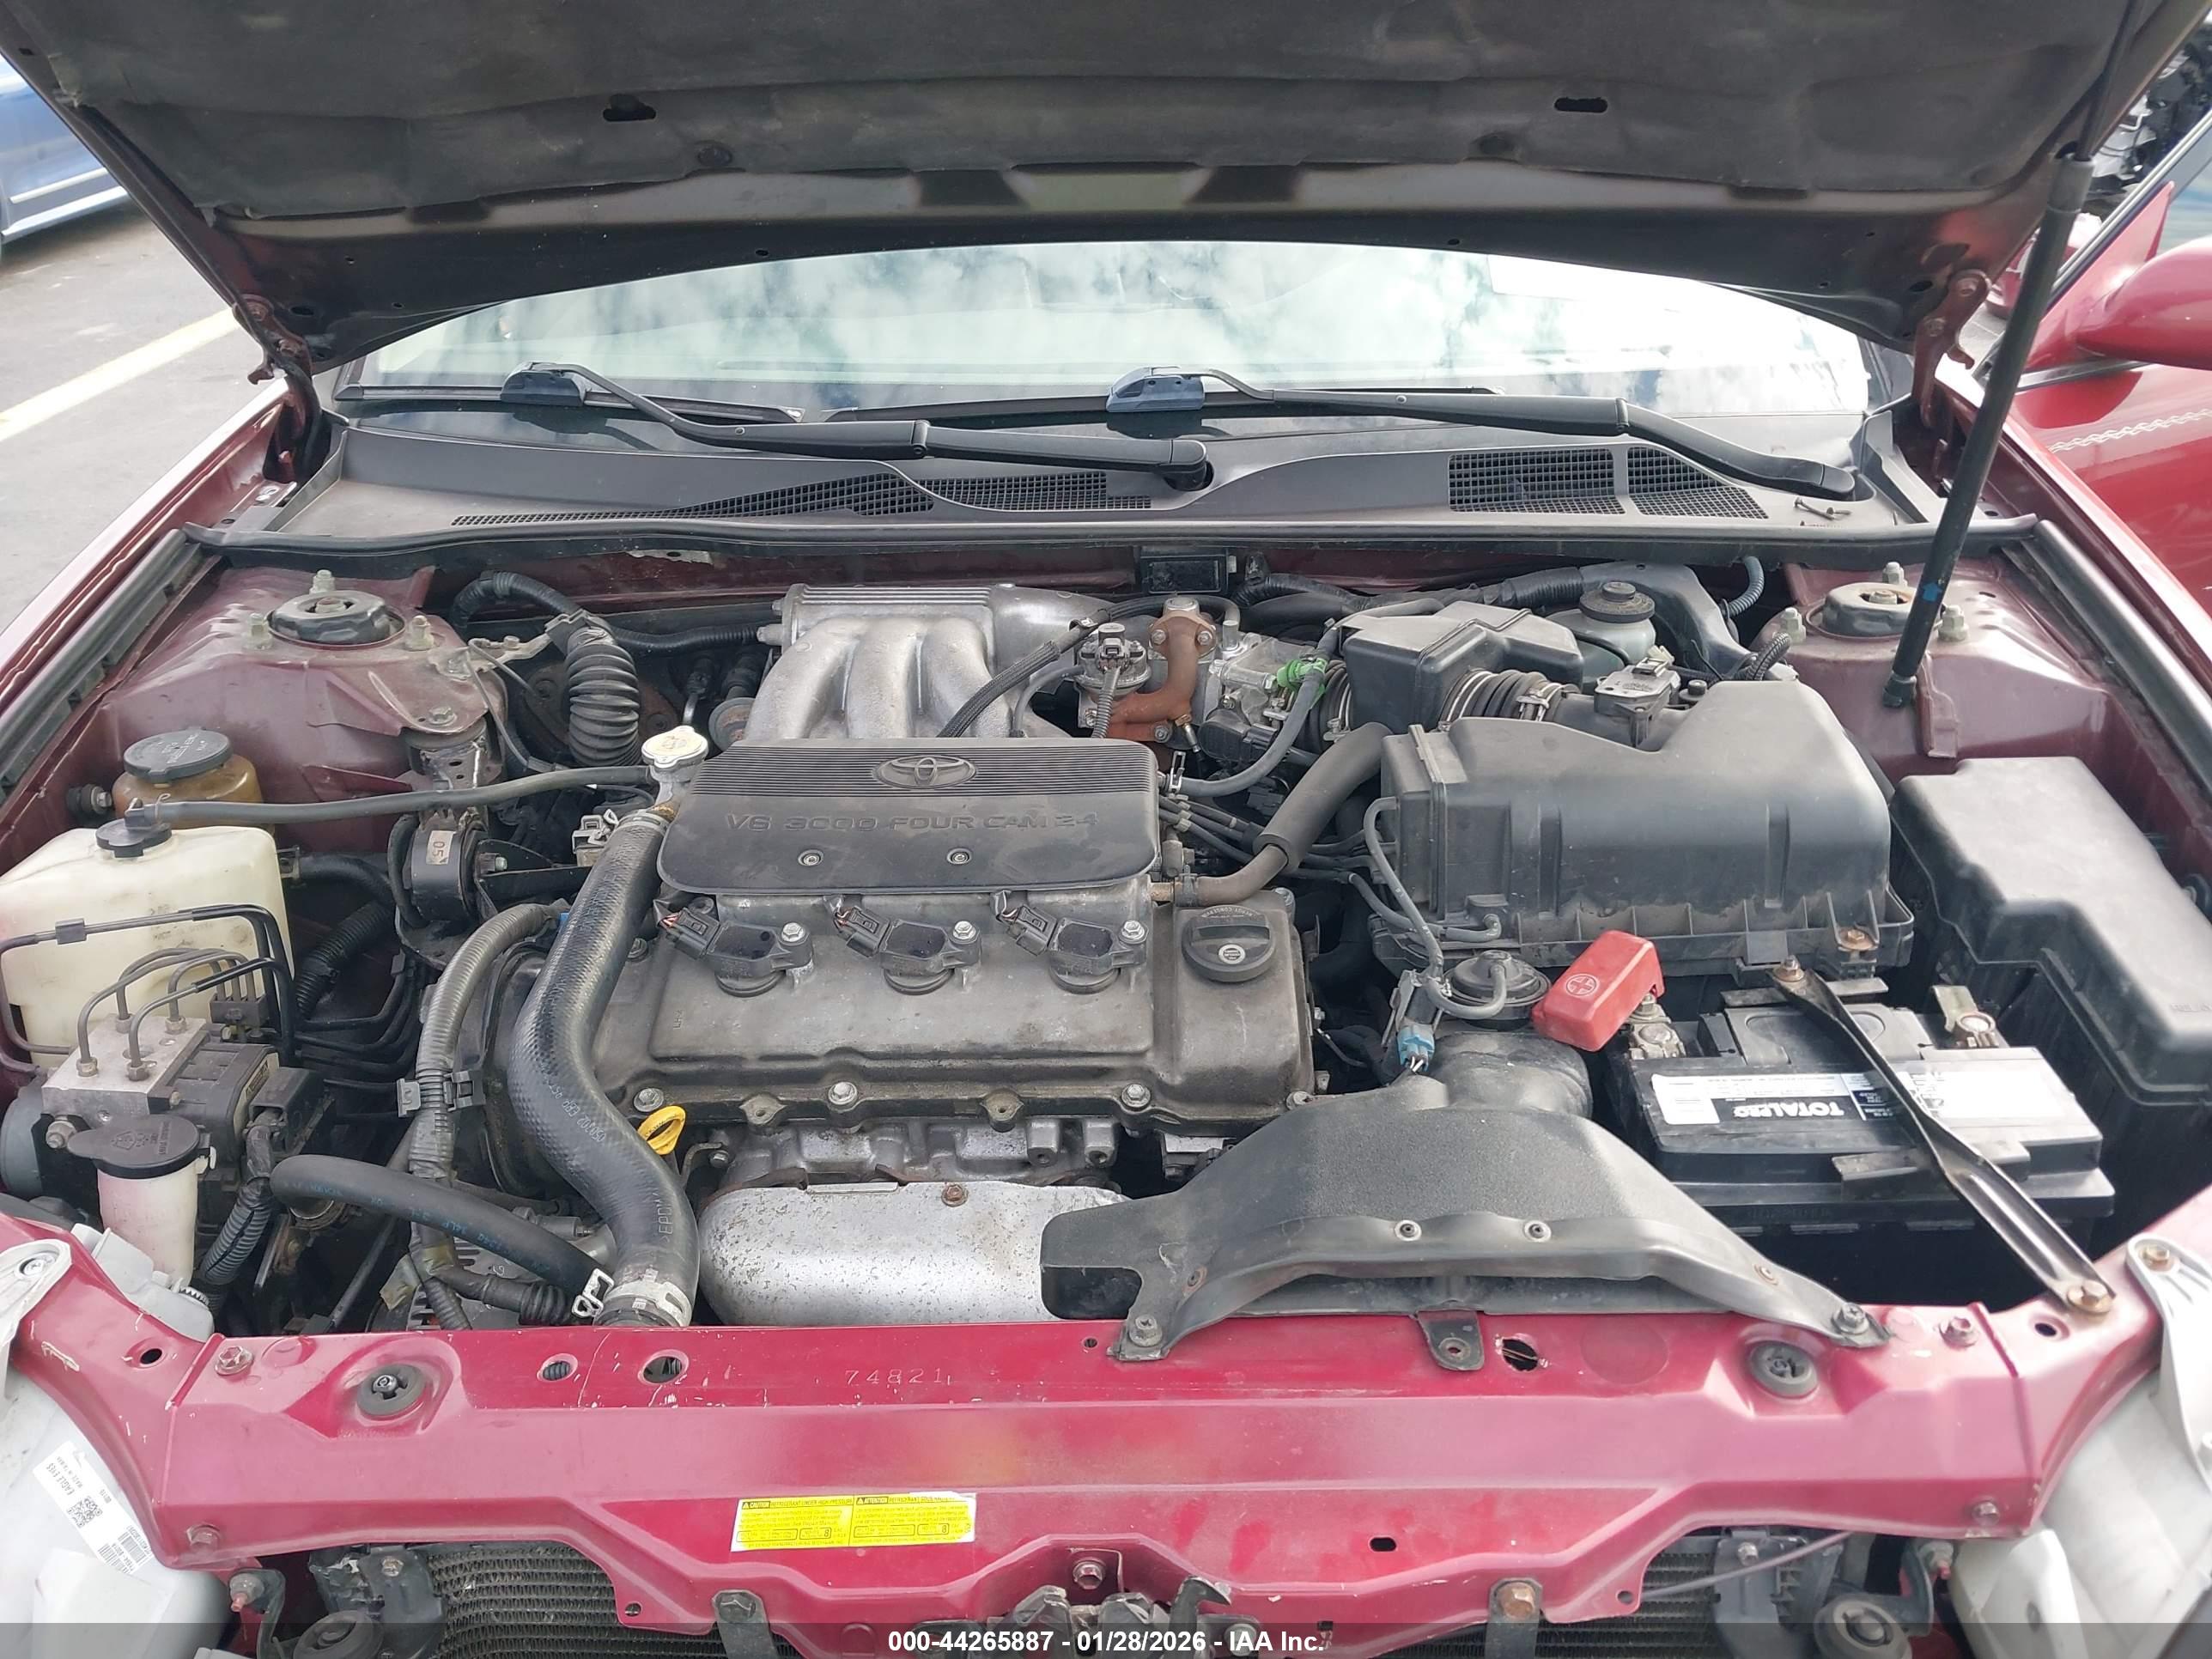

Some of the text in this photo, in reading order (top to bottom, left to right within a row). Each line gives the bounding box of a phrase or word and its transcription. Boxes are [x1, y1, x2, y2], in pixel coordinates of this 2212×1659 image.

[727, 814, 772, 831] V6
[783, 816, 878, 832] 3000
[890, 815, 976, 830] FOUR
[984, 815, 1048, 830] CAM
[1733, 1101, 1845, 1118] TOTALPRO
[845, 1368, 943, 1386] 74821
